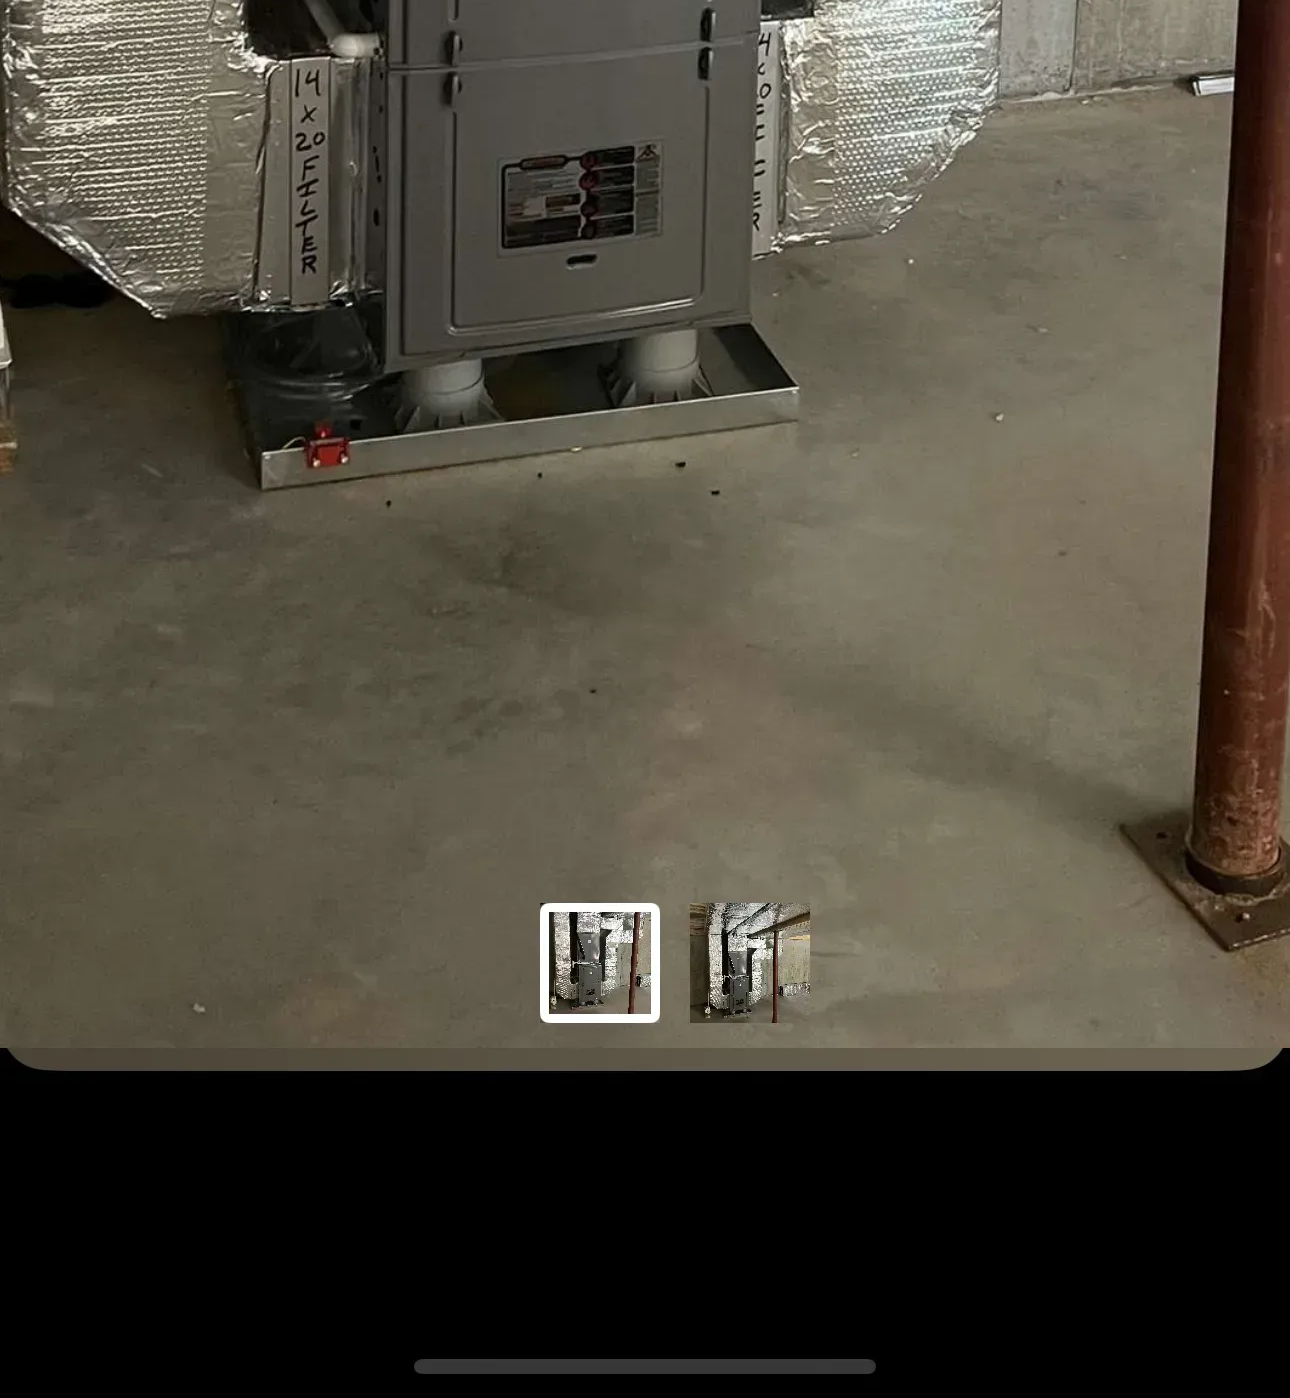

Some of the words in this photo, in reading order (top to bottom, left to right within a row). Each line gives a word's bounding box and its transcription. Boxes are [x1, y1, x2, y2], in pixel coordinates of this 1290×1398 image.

[294, 68, 321, 98] 14
[295, 131, 325, 152] 20
[295, 154, 320, 275] FILTER
